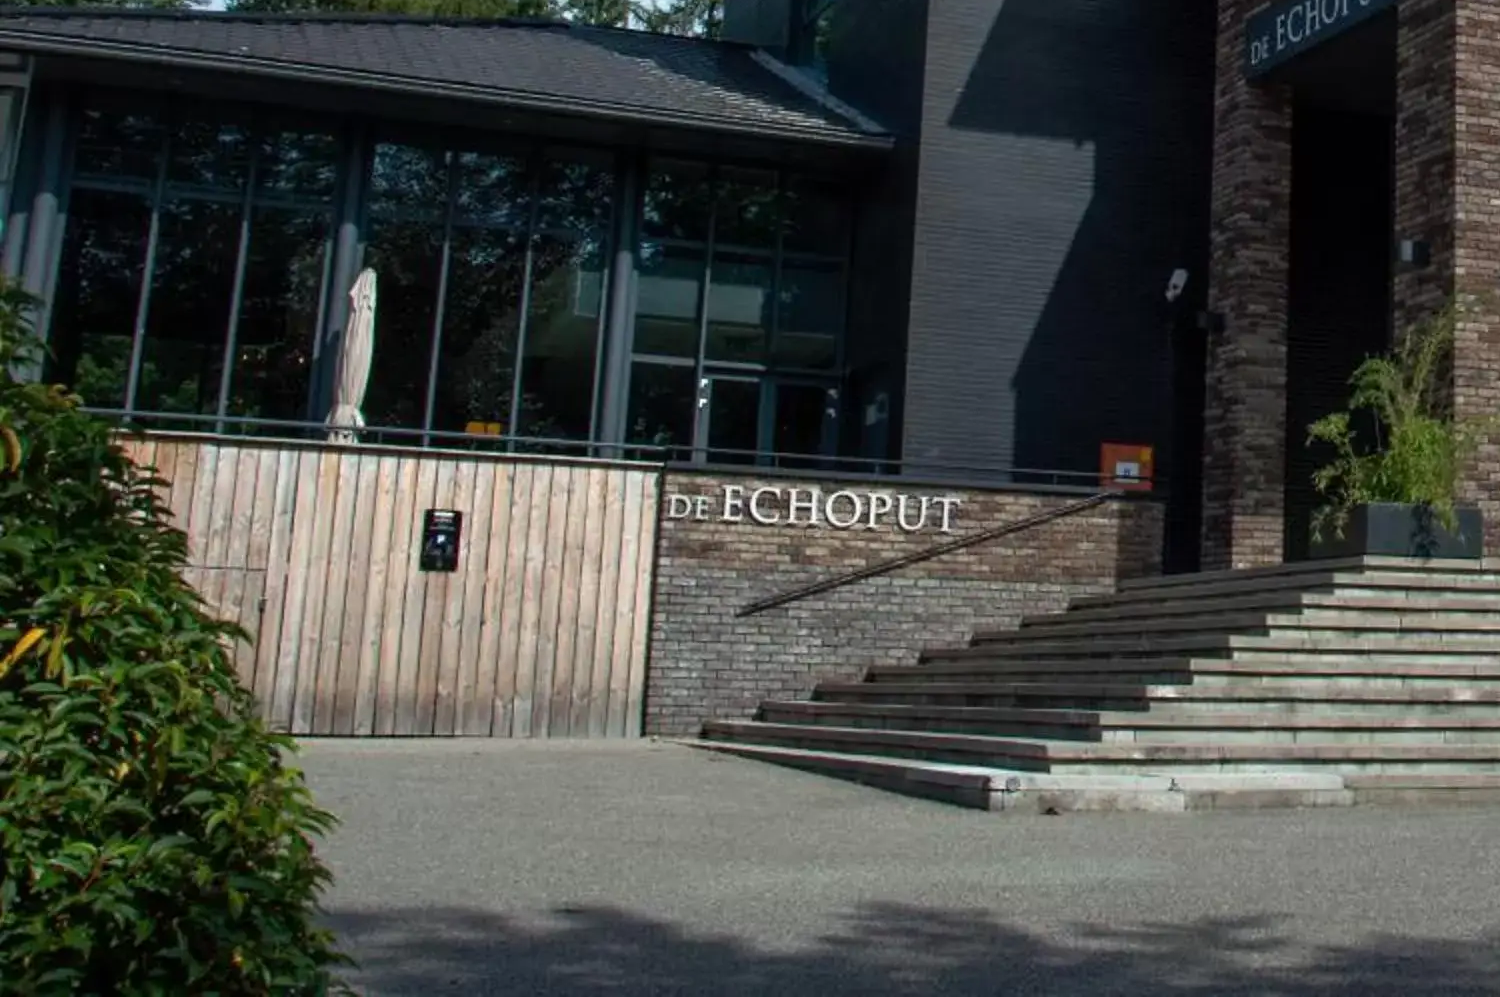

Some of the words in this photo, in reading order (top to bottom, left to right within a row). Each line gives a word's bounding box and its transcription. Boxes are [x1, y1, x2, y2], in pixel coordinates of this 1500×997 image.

[1251, 35, 1271, 65] DE
[667, 494, 709, 520] DE
[720, 484, 961, 533] ECHOPUT
